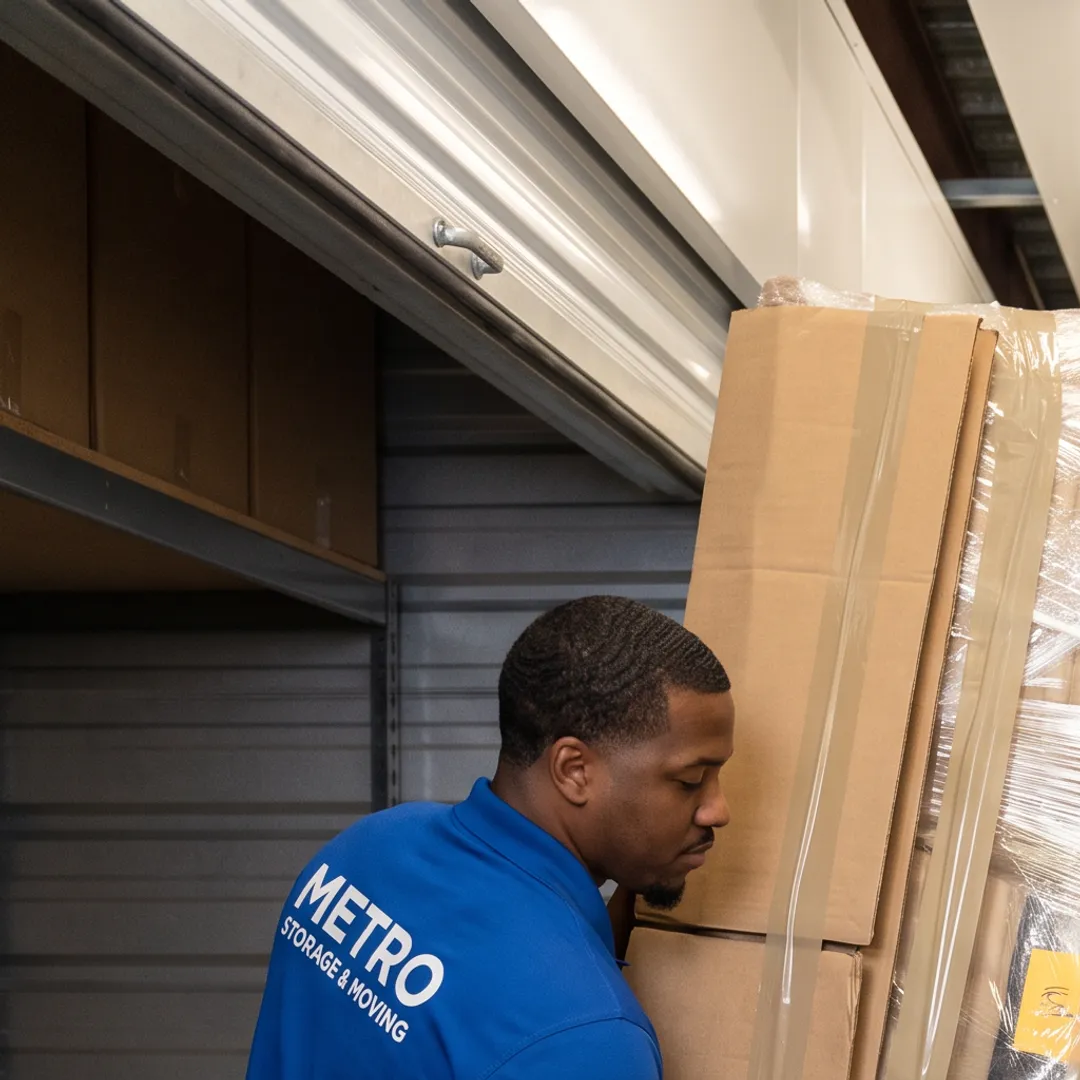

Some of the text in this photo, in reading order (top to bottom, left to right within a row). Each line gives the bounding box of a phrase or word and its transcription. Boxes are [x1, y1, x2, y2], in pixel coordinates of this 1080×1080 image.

[281, 916, 409, 1043] STORAGE & MOVING
[293, 863, 444, 1007] METRO
